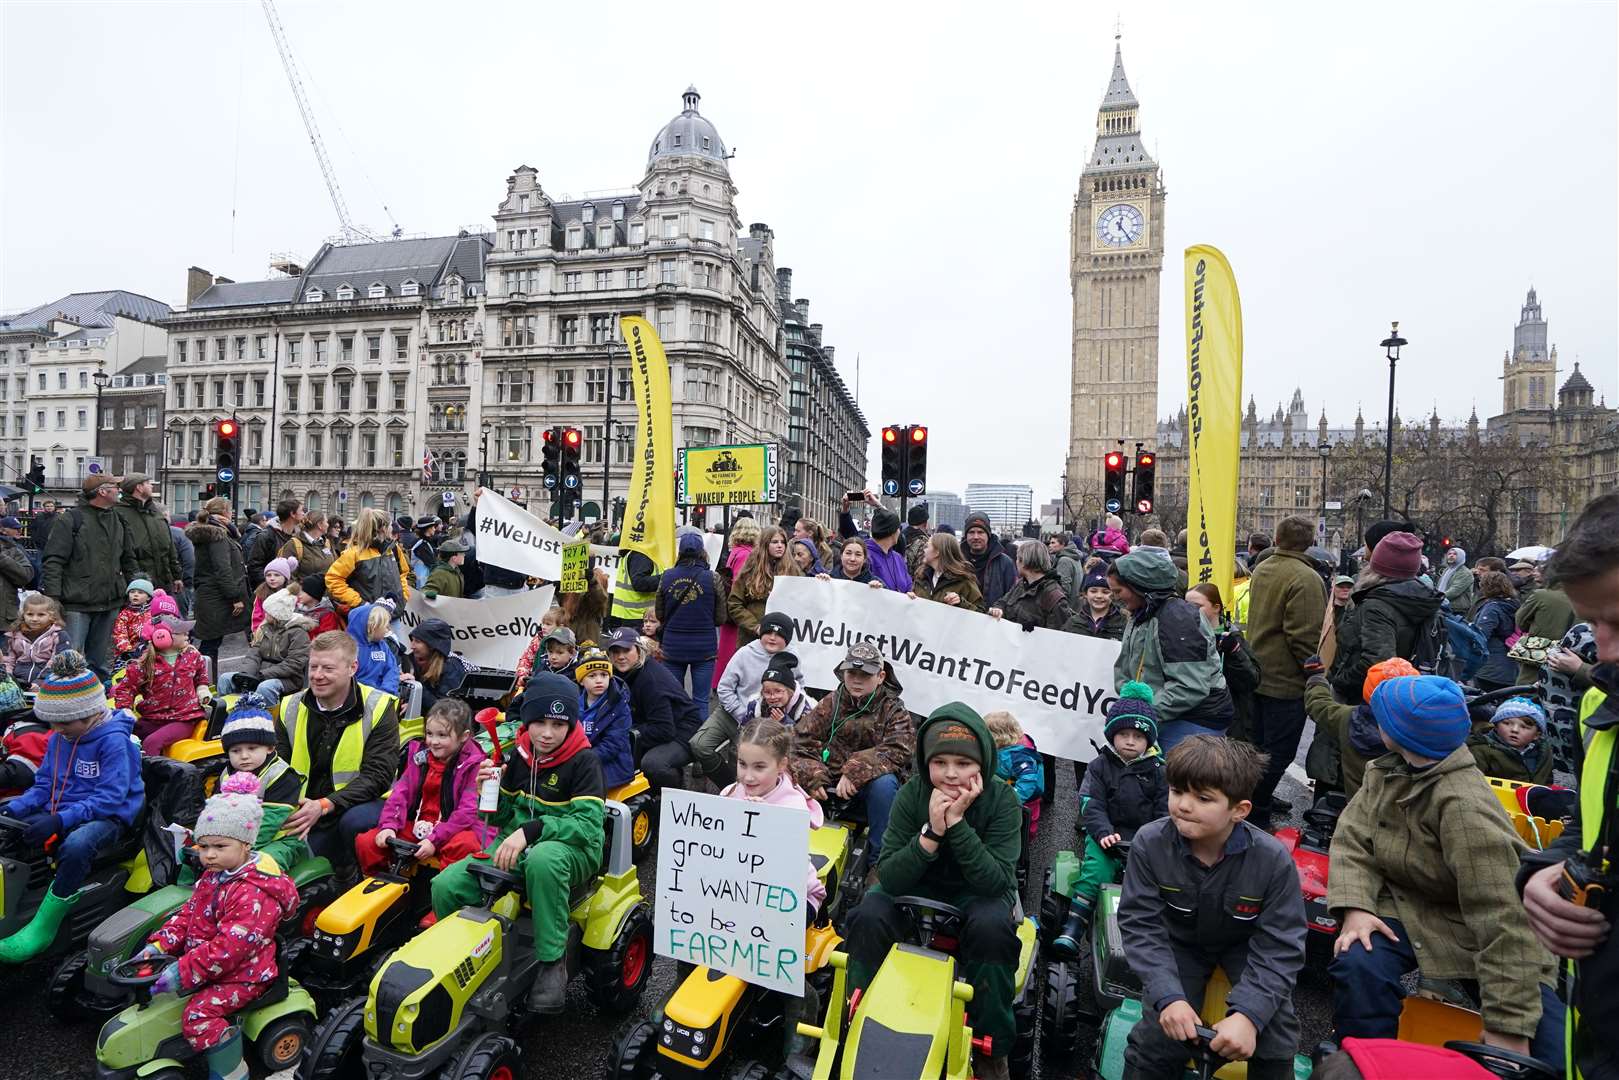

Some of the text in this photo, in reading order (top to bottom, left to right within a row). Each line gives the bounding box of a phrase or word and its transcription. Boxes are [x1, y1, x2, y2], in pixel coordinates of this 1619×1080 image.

[768, 453, 777, 499] LOVE
[695, 490, 756, 504] WAKEUP PEOPLE
[563, 545, 587, 559] TRY A
[563, 560, 588, 571] DAY IN
[562, 572, 577, 581] OUR
[586, 663, 609, 671] JCB
[793, 618, 1119, 717] WeJustWantToFeedYo
[671, 800, 761, 838] When I
[672, 839, 765, 873] grow up
[668, 868, 798, 913] I WANTED
[670, 900, 771, 943] to be a
[670, 928, 798, 983] FARMER
[676, 1027, 690, 1037] JCB
